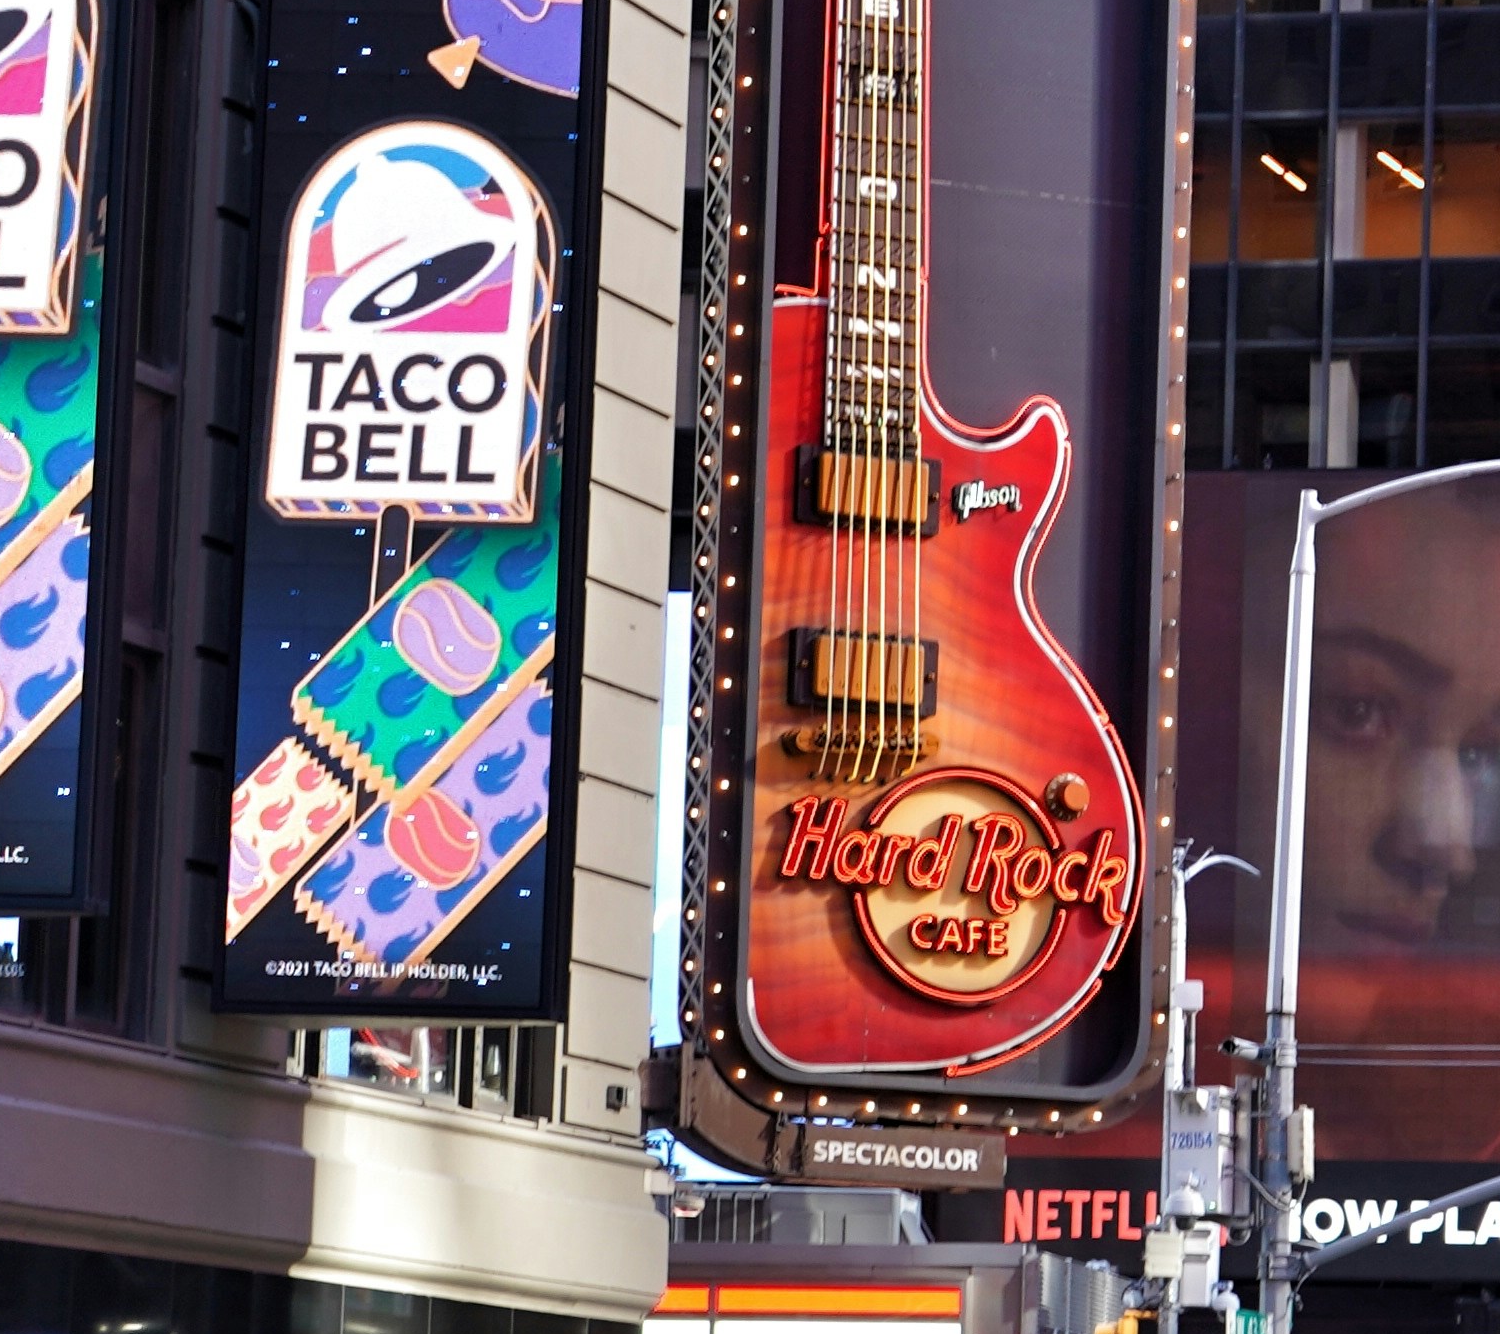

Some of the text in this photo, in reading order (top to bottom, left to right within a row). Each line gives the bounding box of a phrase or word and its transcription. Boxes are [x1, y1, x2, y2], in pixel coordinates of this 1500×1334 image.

[294, 353, 508, 414] TACO
[300, 422, 496, 483] BELL
[781, 794, 1129, 925] Hard Rock
[909, 913, 1011, 959] CAFE
[313, 961, 352, 978] TACO
[354, 962, 388, 979] BELL
[390, 963, 405, 979] IP
[408, 963, 470, 983] HOLDER,
[812, 1138, 980, 1173] SPECTACOLOR
[1004, 1188, 1227, 1247] NETFLI
